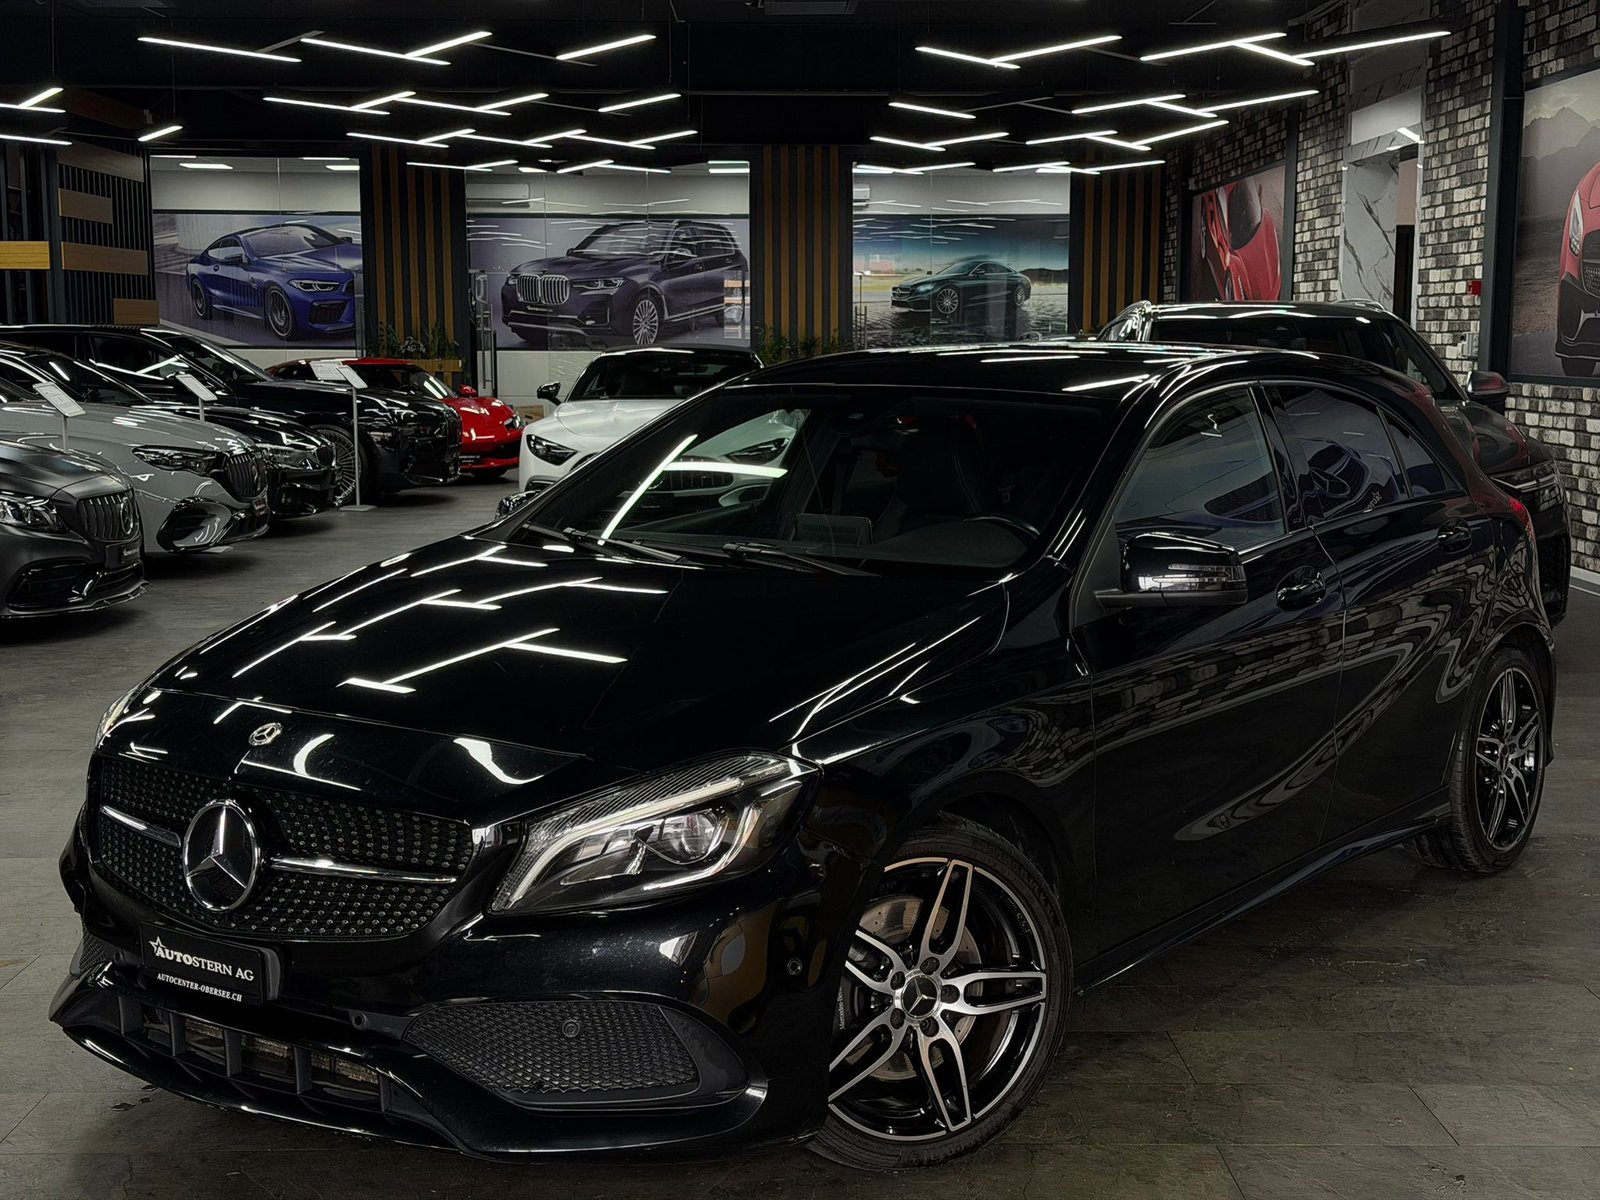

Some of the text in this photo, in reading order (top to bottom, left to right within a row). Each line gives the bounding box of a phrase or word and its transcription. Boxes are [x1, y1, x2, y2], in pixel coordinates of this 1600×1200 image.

[155, 946, 254, 981] AUTOSTERN AG
[156, 973, 242, 1002] AUTOCENTER-OBERSEE.CH
